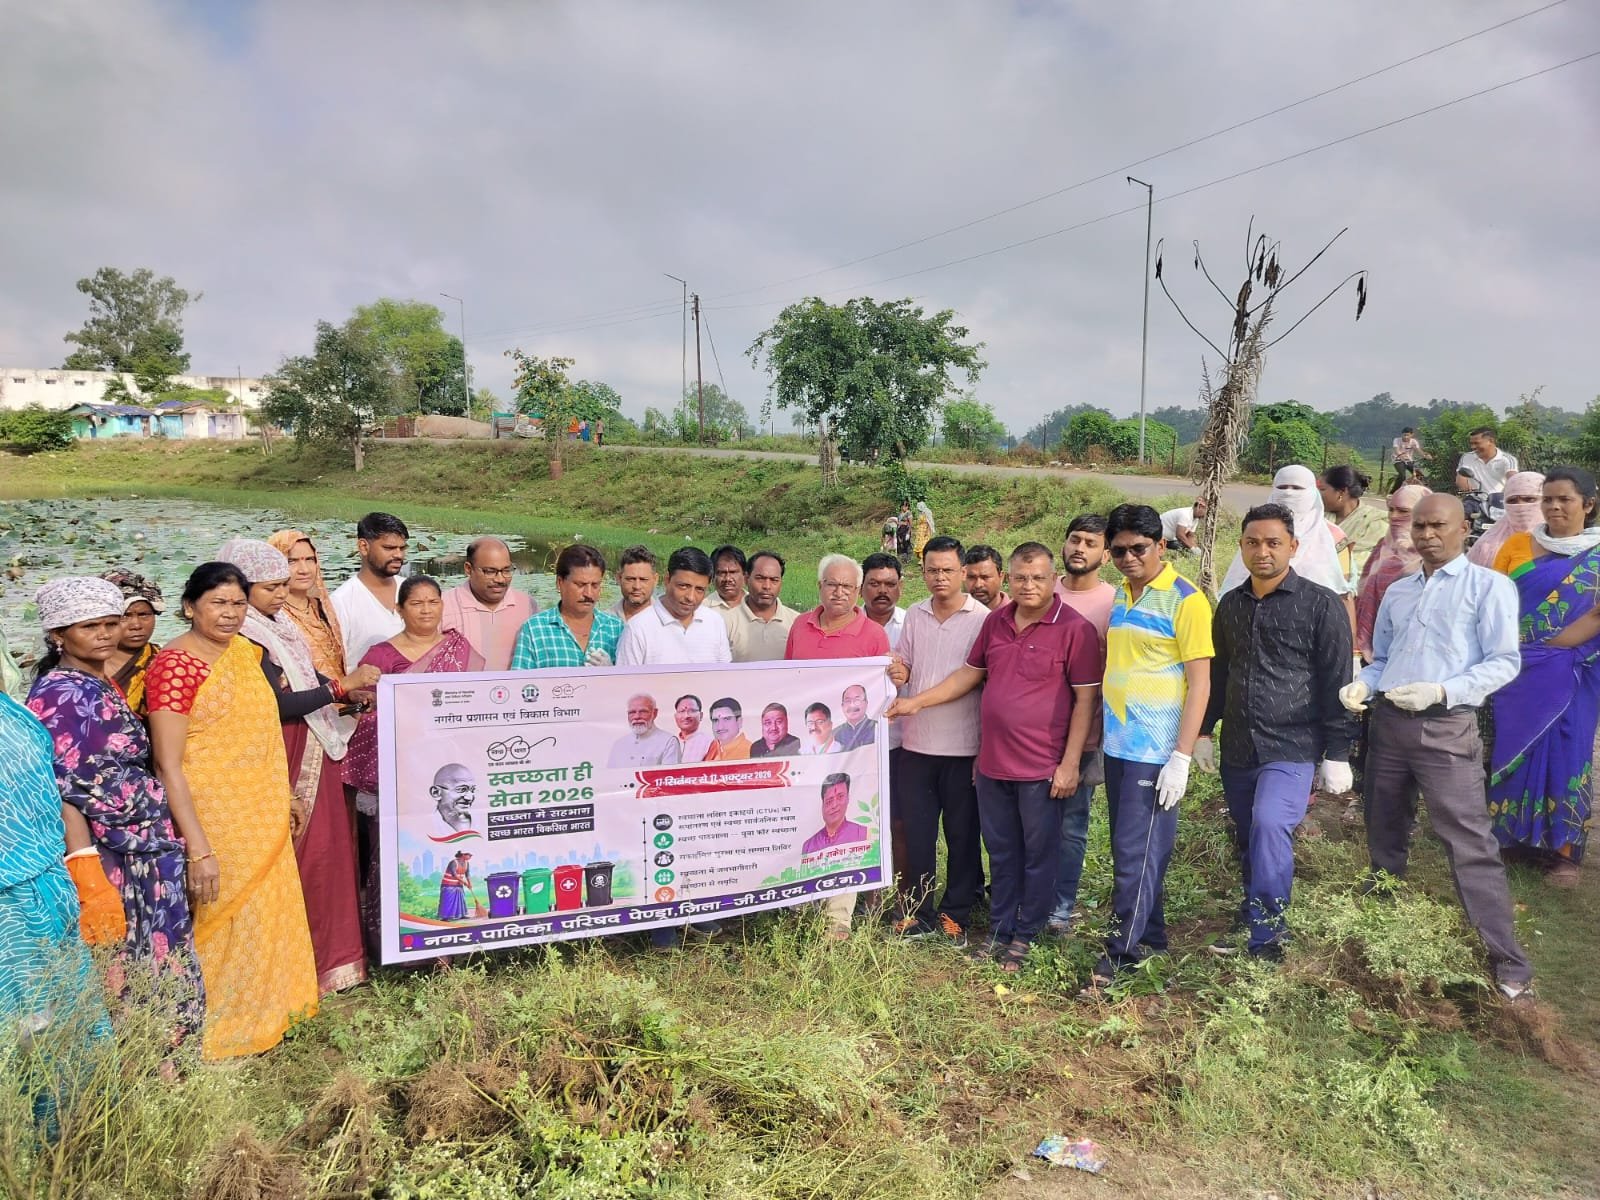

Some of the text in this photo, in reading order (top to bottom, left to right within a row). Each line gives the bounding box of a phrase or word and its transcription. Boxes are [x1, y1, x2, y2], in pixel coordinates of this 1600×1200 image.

[434, 706, 580, 723] नगरीय प्रशासन एवं विकास विभाग
[487, 761, 594, 787] स्वच्छता ही
[487, 787, 594, 808] सेवा 2026
[489, 812, 532, 823] स्वच्छता
[488, 820, 591, 839] स्वच्छ भारत विकसित भारत
[423, 932, 473, 947] नगर
[481, 922, 553, 939] पालिका
[561, 914, 622, 930] परिषद
